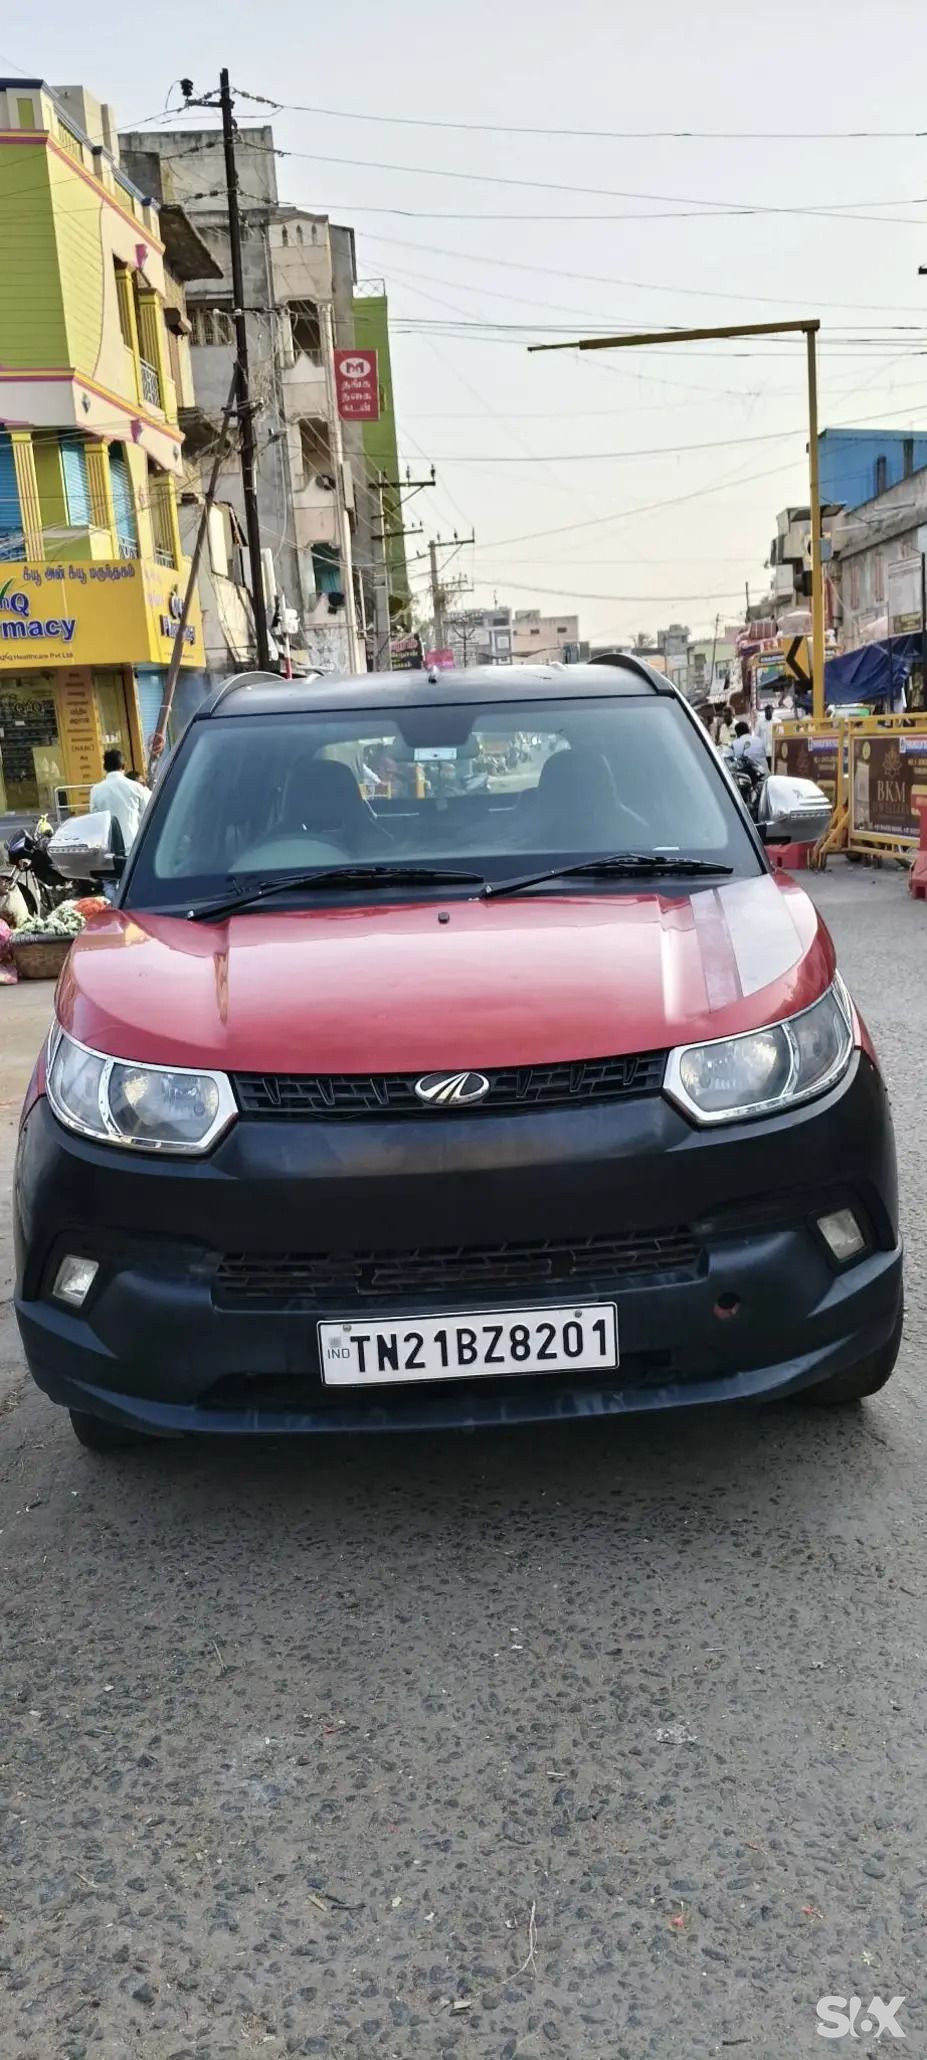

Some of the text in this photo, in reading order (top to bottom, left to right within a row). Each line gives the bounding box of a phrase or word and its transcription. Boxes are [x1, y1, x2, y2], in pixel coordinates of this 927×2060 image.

[877, 780, 906, 802] BKM
[327, 1319, 608, 1373] IND TN21BZ8201
